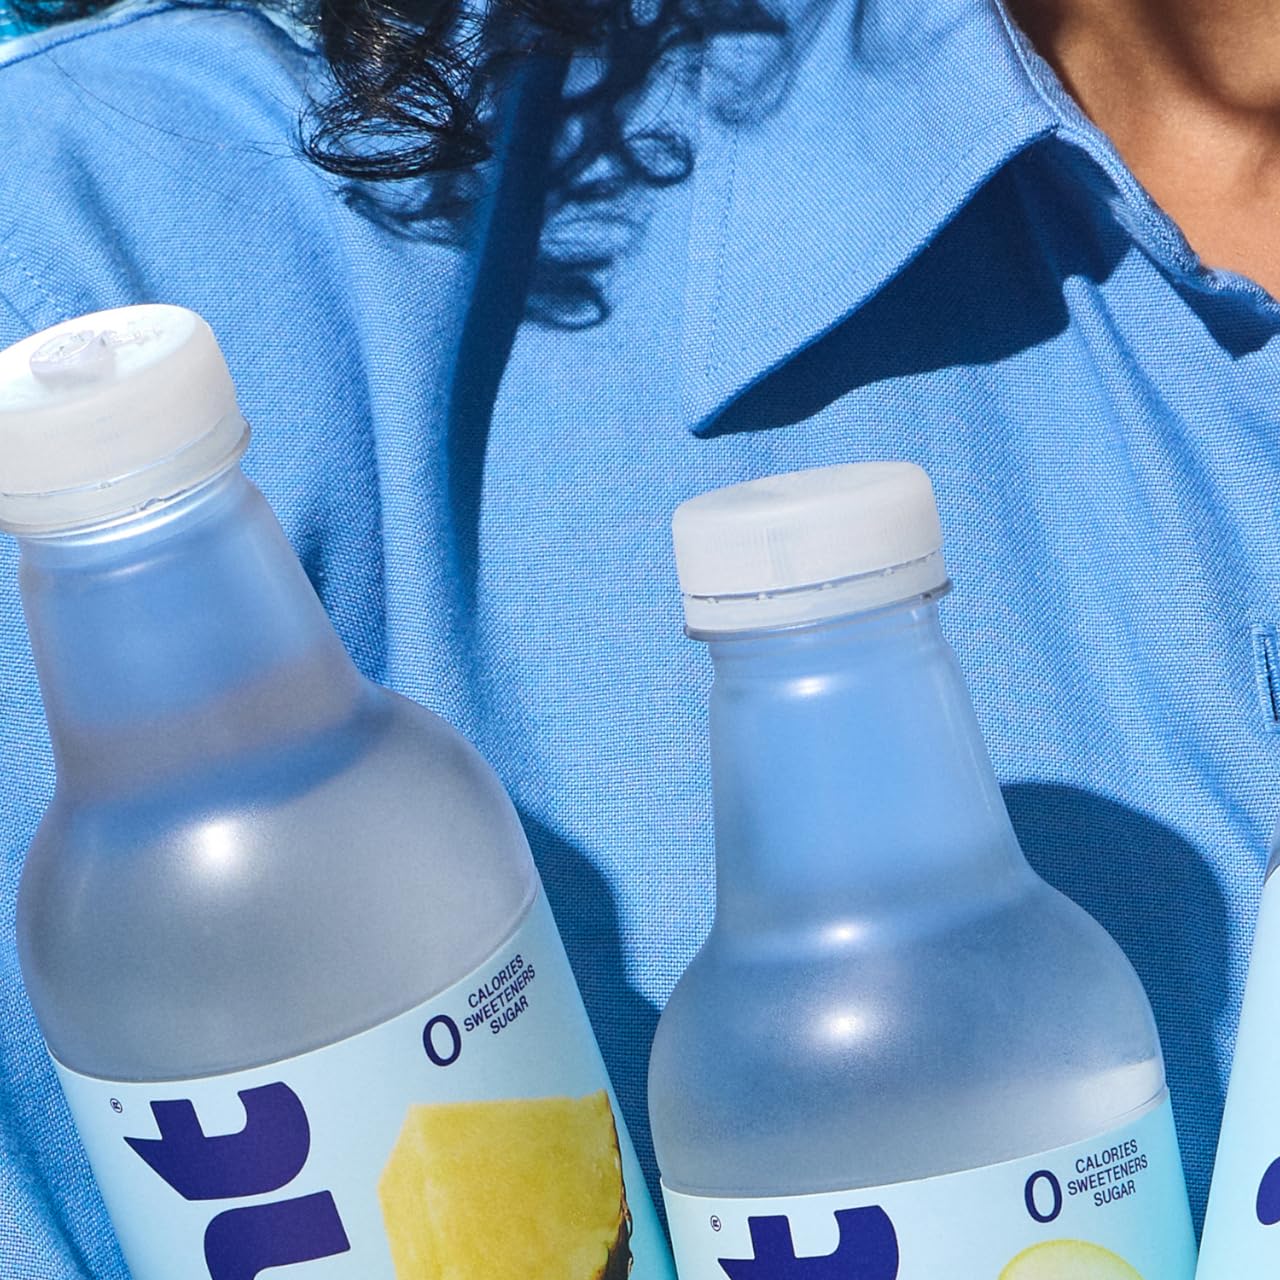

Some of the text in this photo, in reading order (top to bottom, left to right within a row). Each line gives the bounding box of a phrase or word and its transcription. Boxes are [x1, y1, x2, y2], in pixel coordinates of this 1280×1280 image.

[463, 964, 535, 1032] SWEETENERS
[468, 954, 524, 1008] CALORIES
[490, 995, 529, 1034] SUGAR
[423, 1014, 462, 1067] 0
[1067, 1154, 1148, 1195] SWEETENERS
[1075, 1139, 1138, 1173] CALORIES
[1024, 1169, 1063, 1223] 0
[1094, 1180, 1136, 1206] SUGAR
